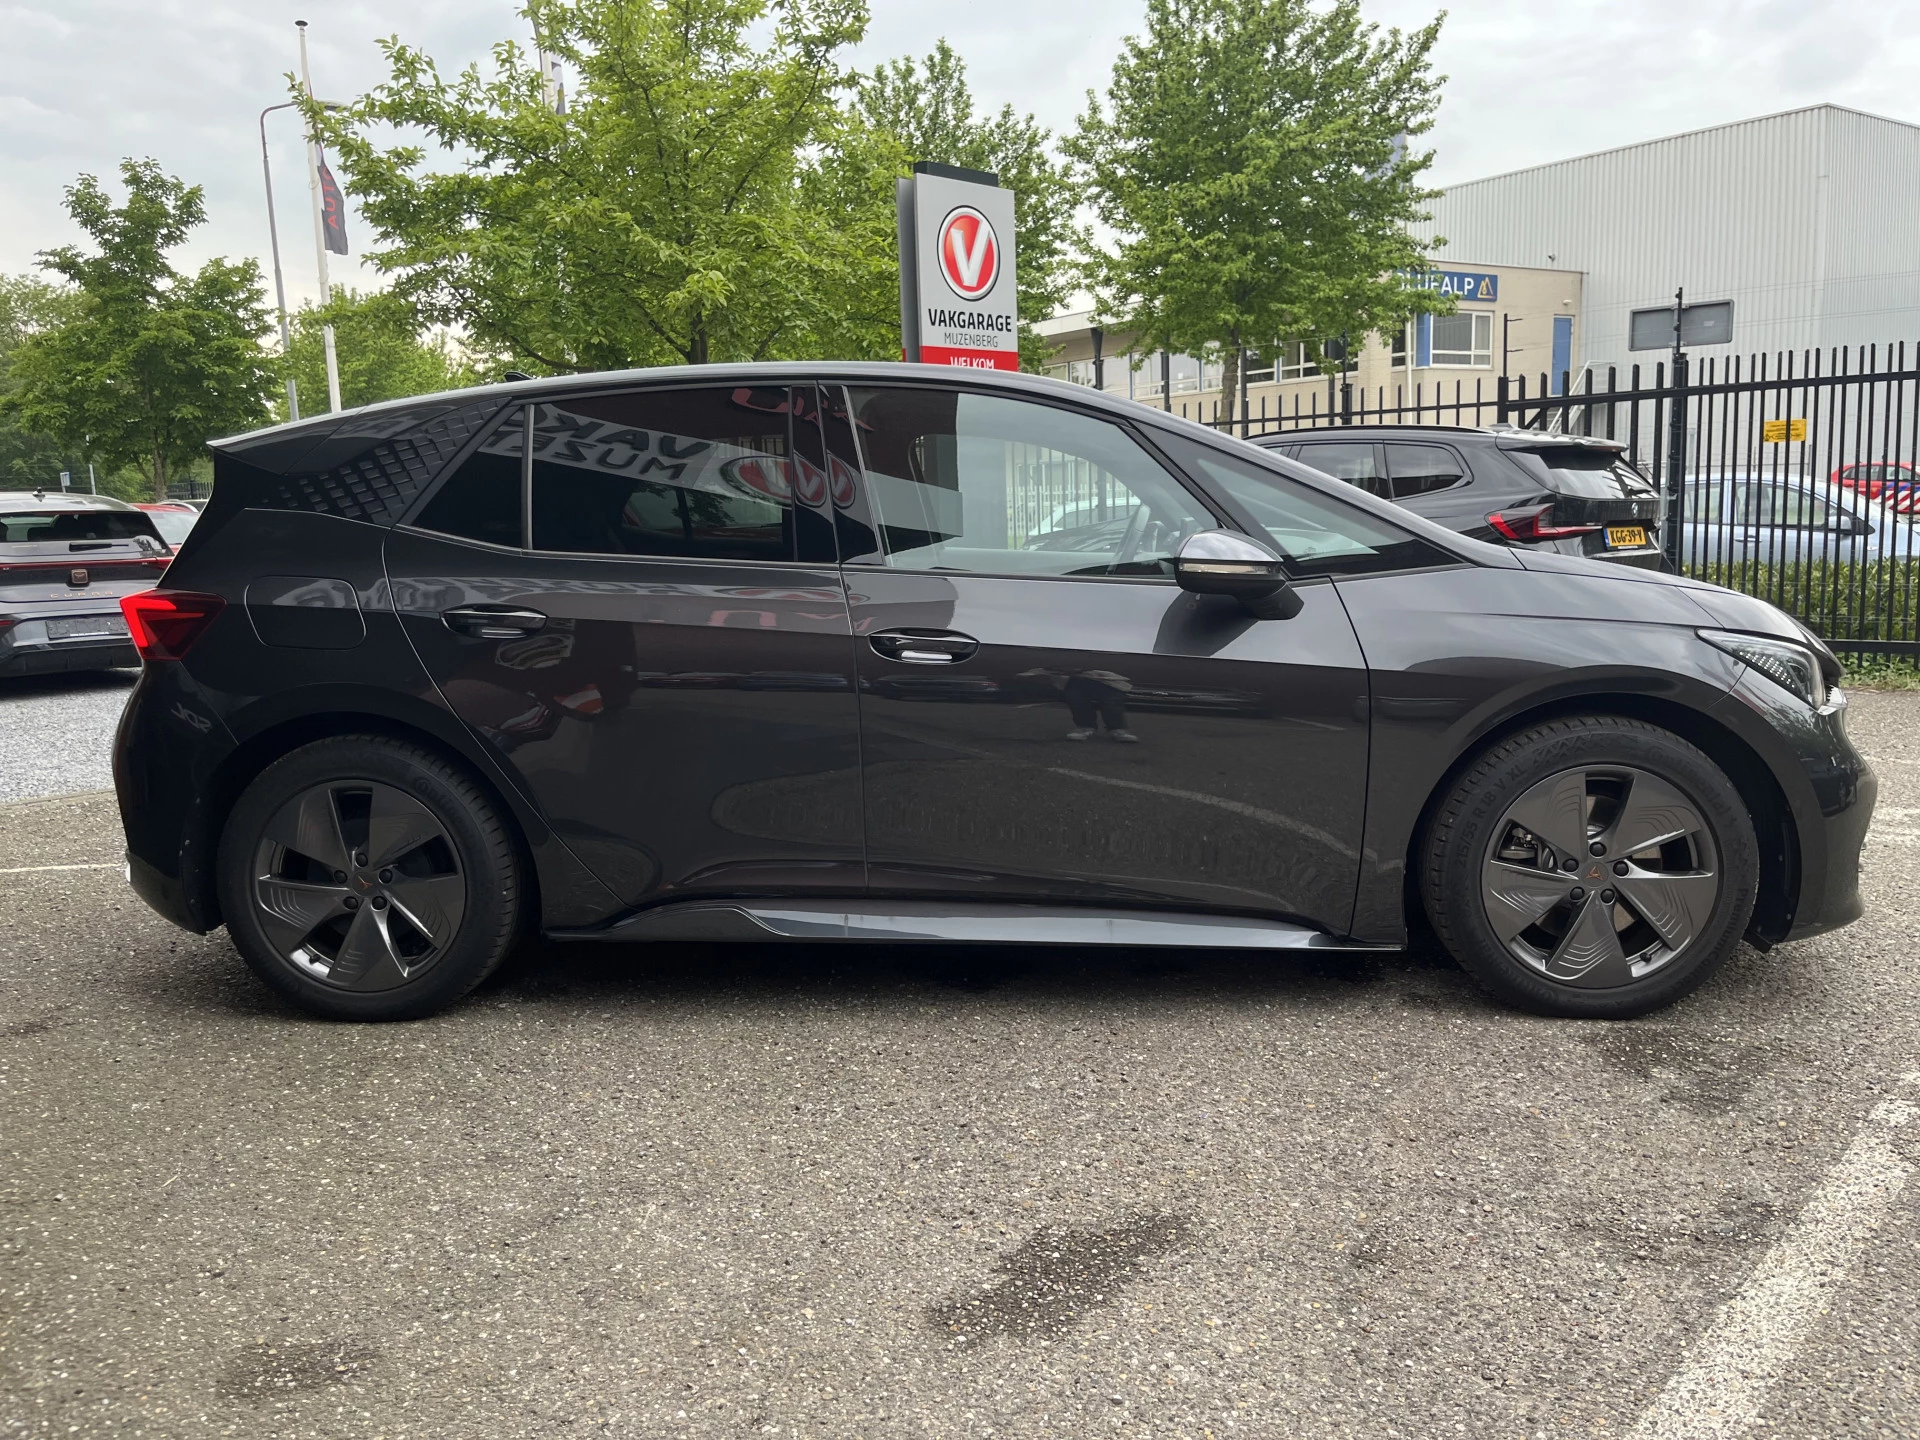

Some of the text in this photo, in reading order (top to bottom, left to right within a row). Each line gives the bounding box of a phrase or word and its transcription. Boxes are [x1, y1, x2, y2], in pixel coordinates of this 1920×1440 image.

[928, 308, 1012, 332] VAKGARAGE
[944, 332, 998, 348] MUZENBERG
[1473, 807, 1487, 819] R
[1481, 791, 1498, 807] 18
[1506, 764, 1529, 781] XL
